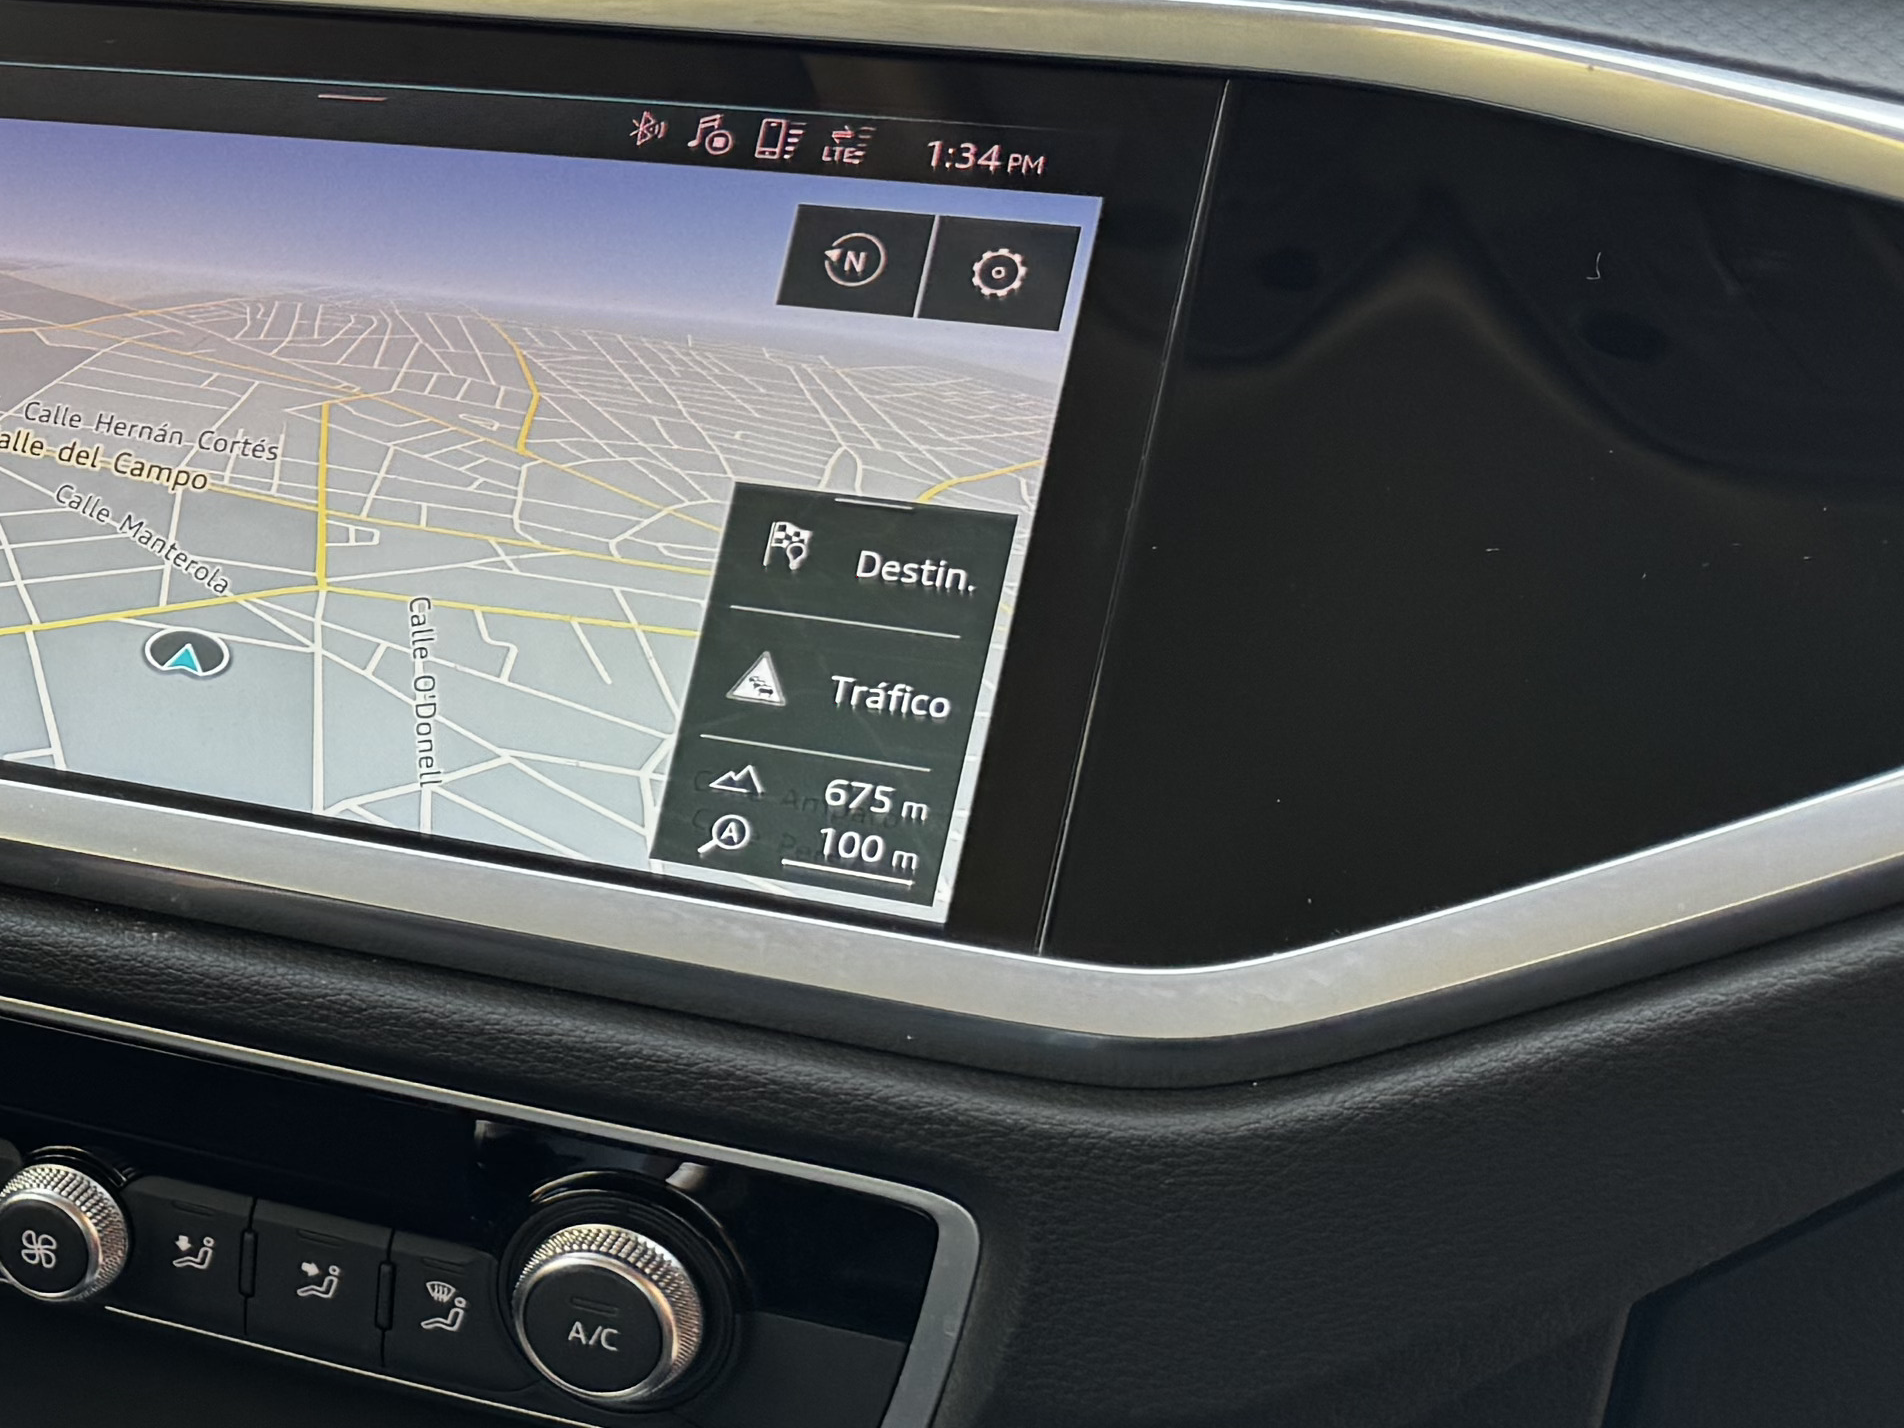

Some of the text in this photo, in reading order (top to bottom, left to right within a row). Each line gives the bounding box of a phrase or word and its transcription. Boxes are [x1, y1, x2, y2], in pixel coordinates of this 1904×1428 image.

[927, 139, 1044, 175] 1:34 PM
[23, 400, 280, 461] Calle Hernán Cortés
[57, 441, 98, 469] del
[113, 451, 209, 493] Campo
[55, 484, 230, 596] Calle Manterola
[856, 550, 977, 592] Destin.
[409, 596, 443, 788] Calle O'Donell
[831, 674, 952, 719] Tráfico
[824, 778, 896, 814] 675
[901, 799, 929, 822] m
[819, 826, 885, 864] 100
[891, 849, 919, 872] m
[567, 1321, 619, 1351] A/C
